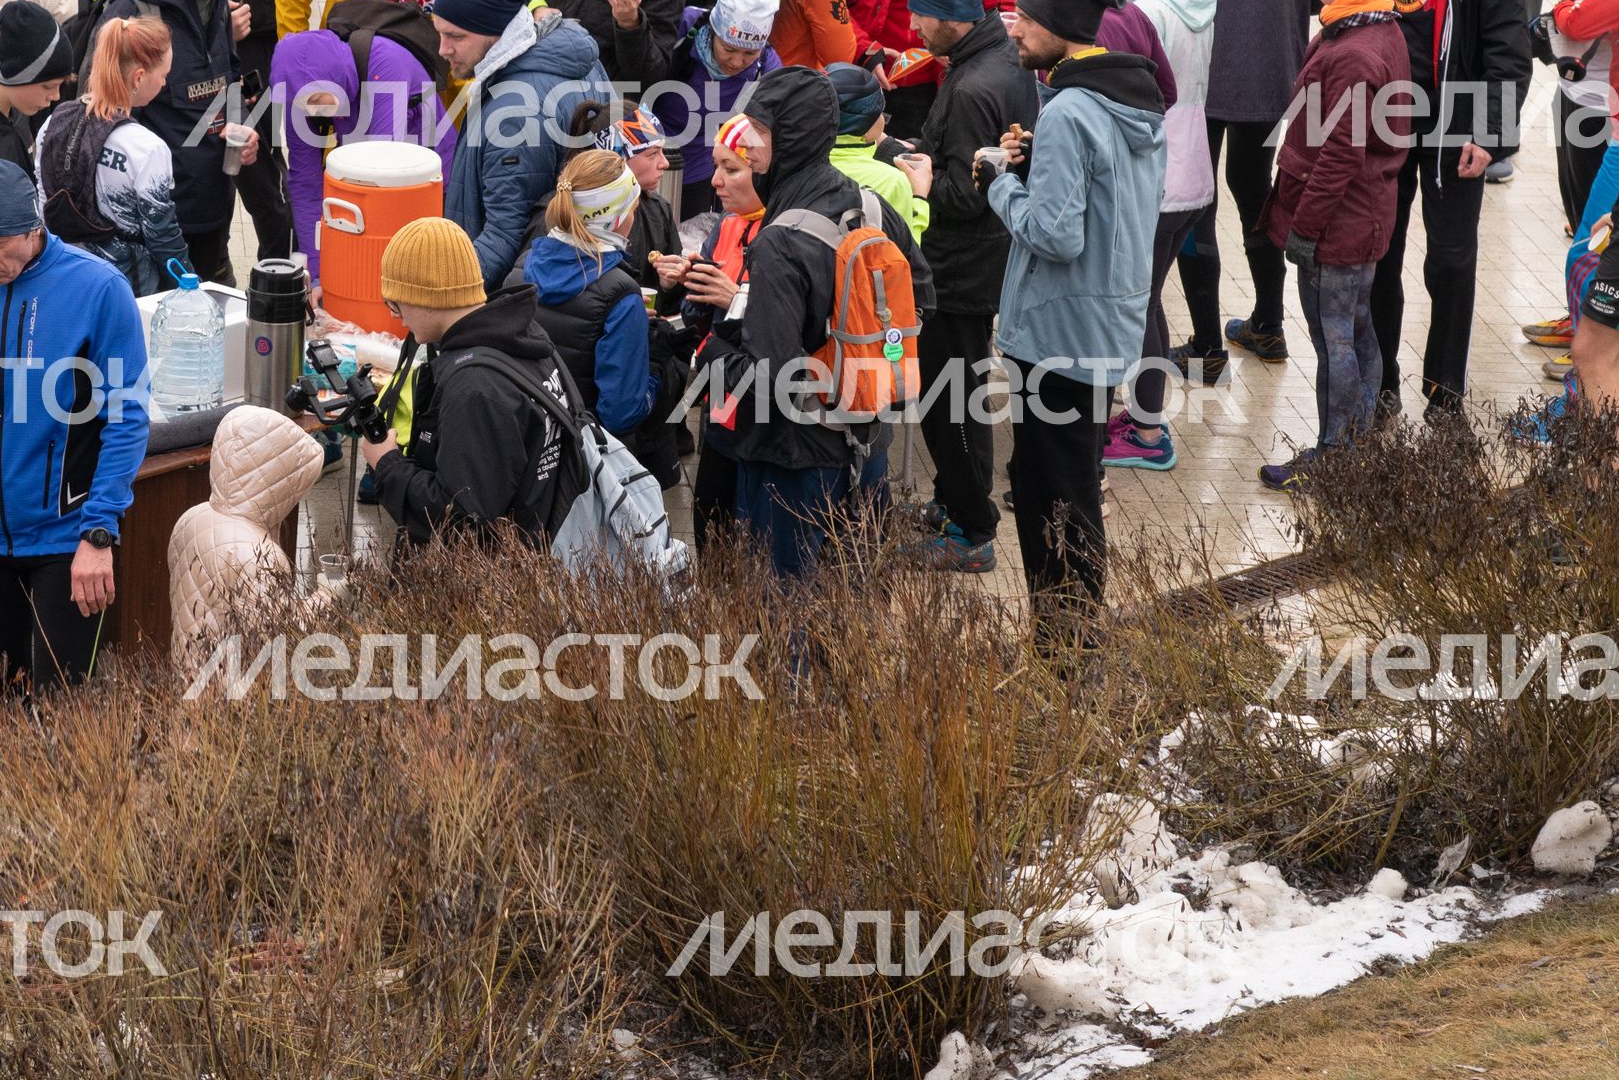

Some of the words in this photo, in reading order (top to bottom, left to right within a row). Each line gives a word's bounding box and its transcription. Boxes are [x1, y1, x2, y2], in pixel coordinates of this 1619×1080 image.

[582, 206, 610, 221] AMP
[1595, 281, 1619, 299] ASICS
[29, 296, 38, 336] VICTORY
